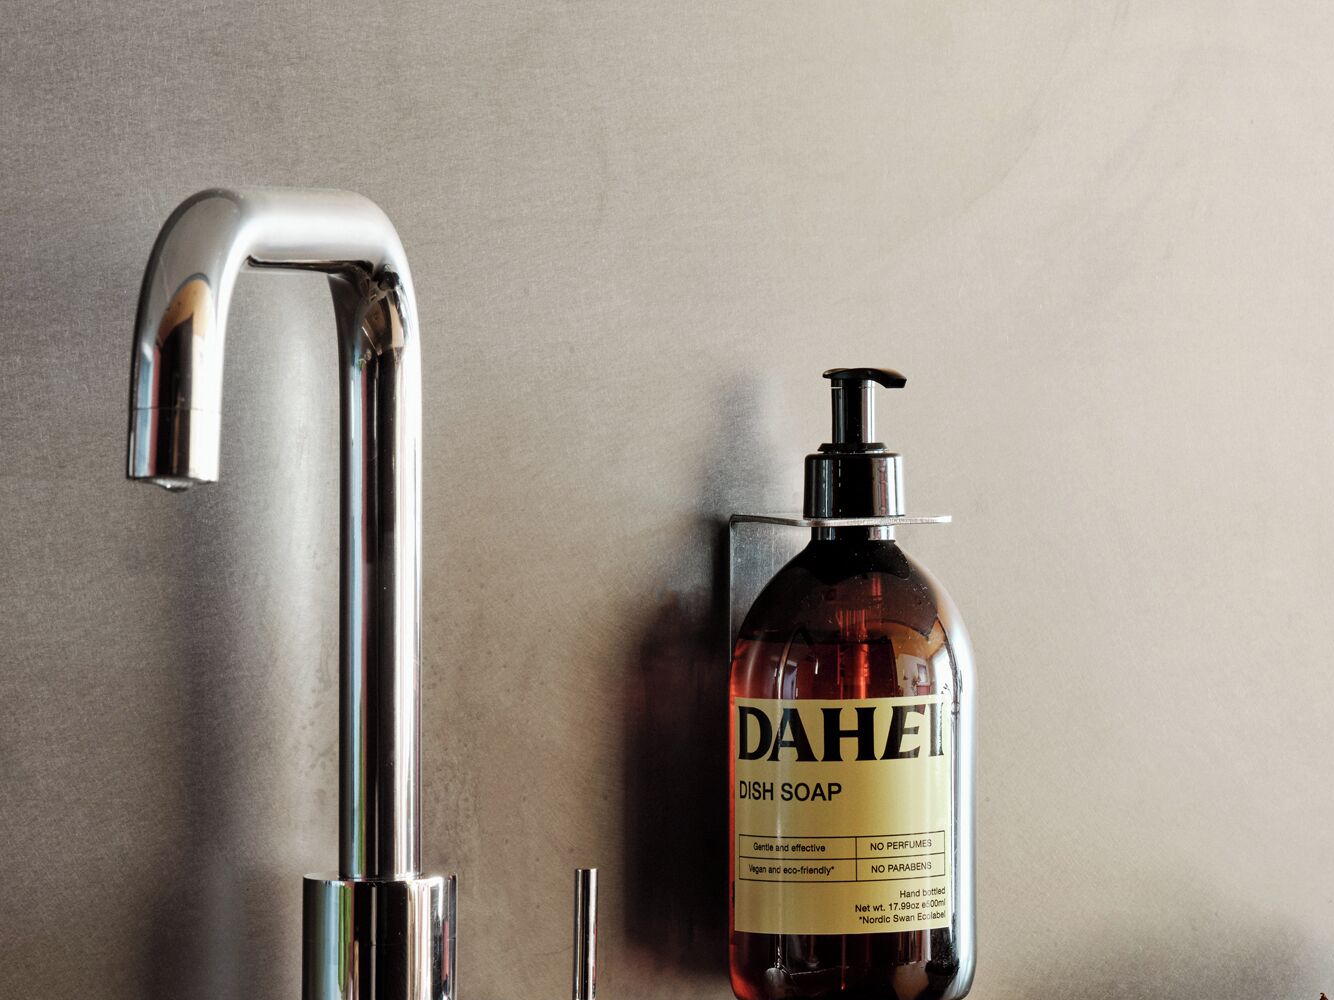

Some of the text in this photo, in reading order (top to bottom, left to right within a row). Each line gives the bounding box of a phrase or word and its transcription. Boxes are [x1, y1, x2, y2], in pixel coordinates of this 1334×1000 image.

[739, 780, 842, 801] DISH SOAP
[753, 842, 826, 852] Gentle and effective
[870, 839, 932, 851] NO PERFUMES
[748, 864, 767, 875] Vegan
[768, 865, 781, 874] and
[871, 862, 932, 873] NO PARABENS
[899, 886, 946, 898] Hand bottled
[855, 904, 870, 913] Net
[872, 904, 886, 912] wt.
[888, 902, 920, 911] 17.99oz
[893, 913, 915, 923] Swan
[917, 910, 946, 921] Ecolabel
